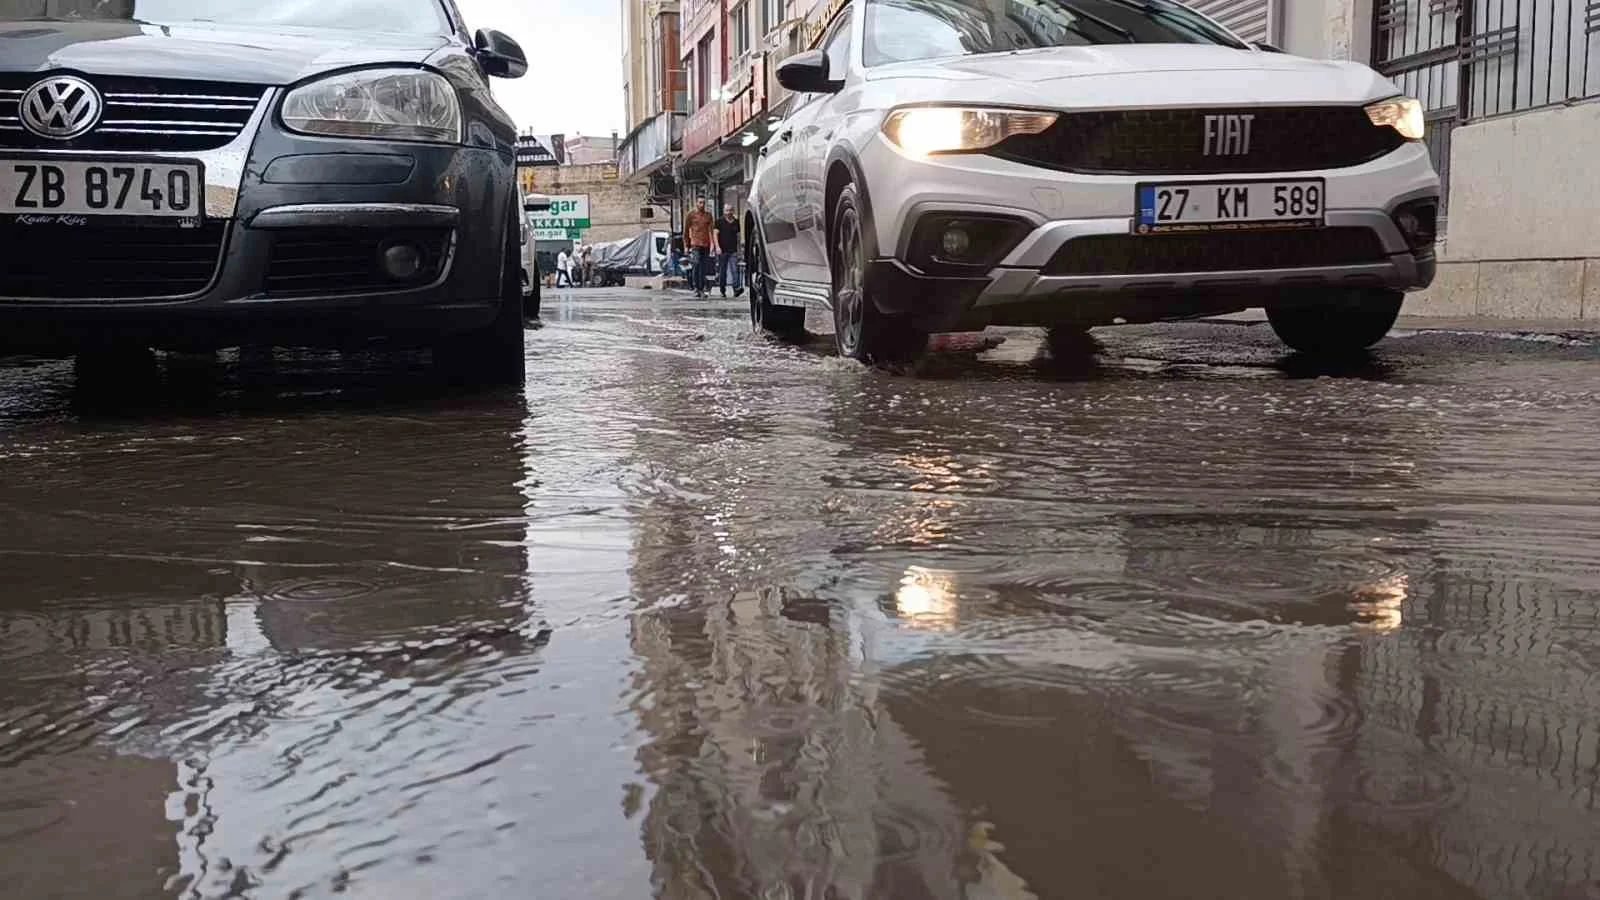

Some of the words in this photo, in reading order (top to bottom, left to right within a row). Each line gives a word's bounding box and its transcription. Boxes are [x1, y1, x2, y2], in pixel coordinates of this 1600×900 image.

[1203, 114, 1255, 155] FIAT
[14, 165, 65, 208] ZB
[85, 167, 190, 210] 8740
[1157, 189, 1190, 220] 27
[1217, 187, 1249, 218] KM
[1274, 185, 1319, 216] 589
